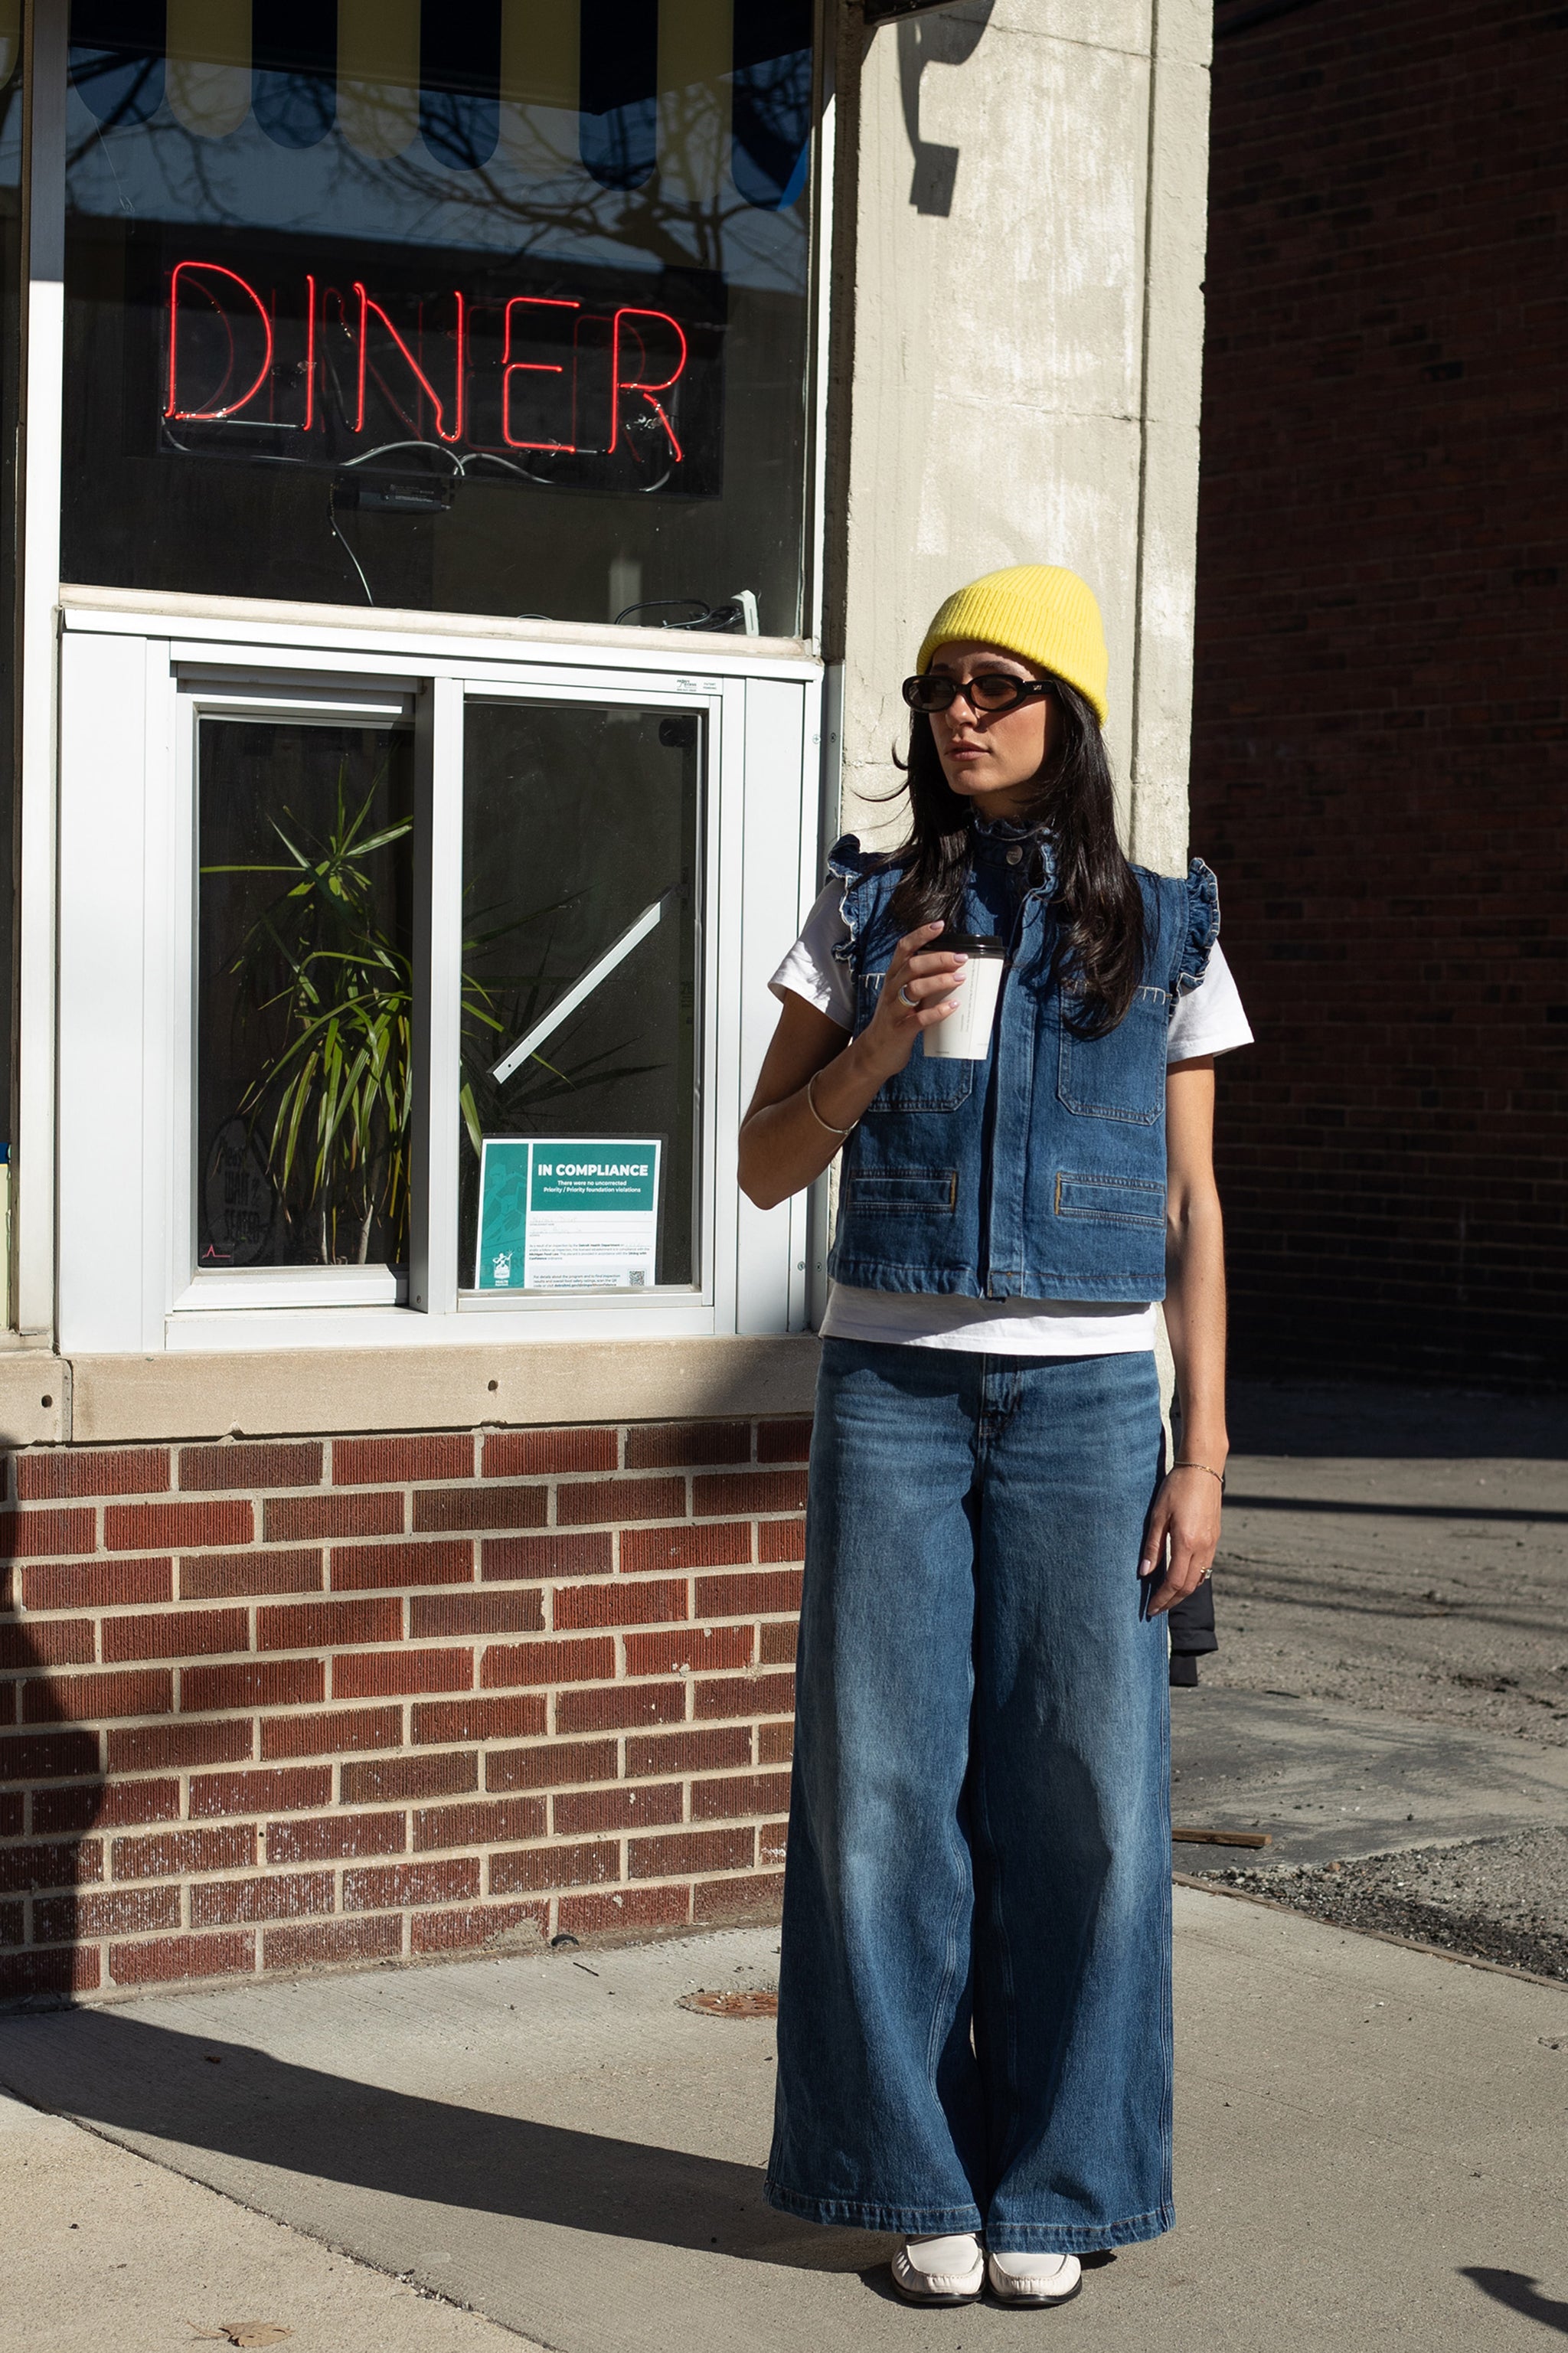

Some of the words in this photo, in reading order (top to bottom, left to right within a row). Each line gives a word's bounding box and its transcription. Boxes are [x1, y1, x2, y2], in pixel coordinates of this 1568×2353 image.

[162, 261, 687, 462] DINER
[537, 1164, 553, 1176] IN
[555, 1164, 648, 1176] COMPLIANCE
